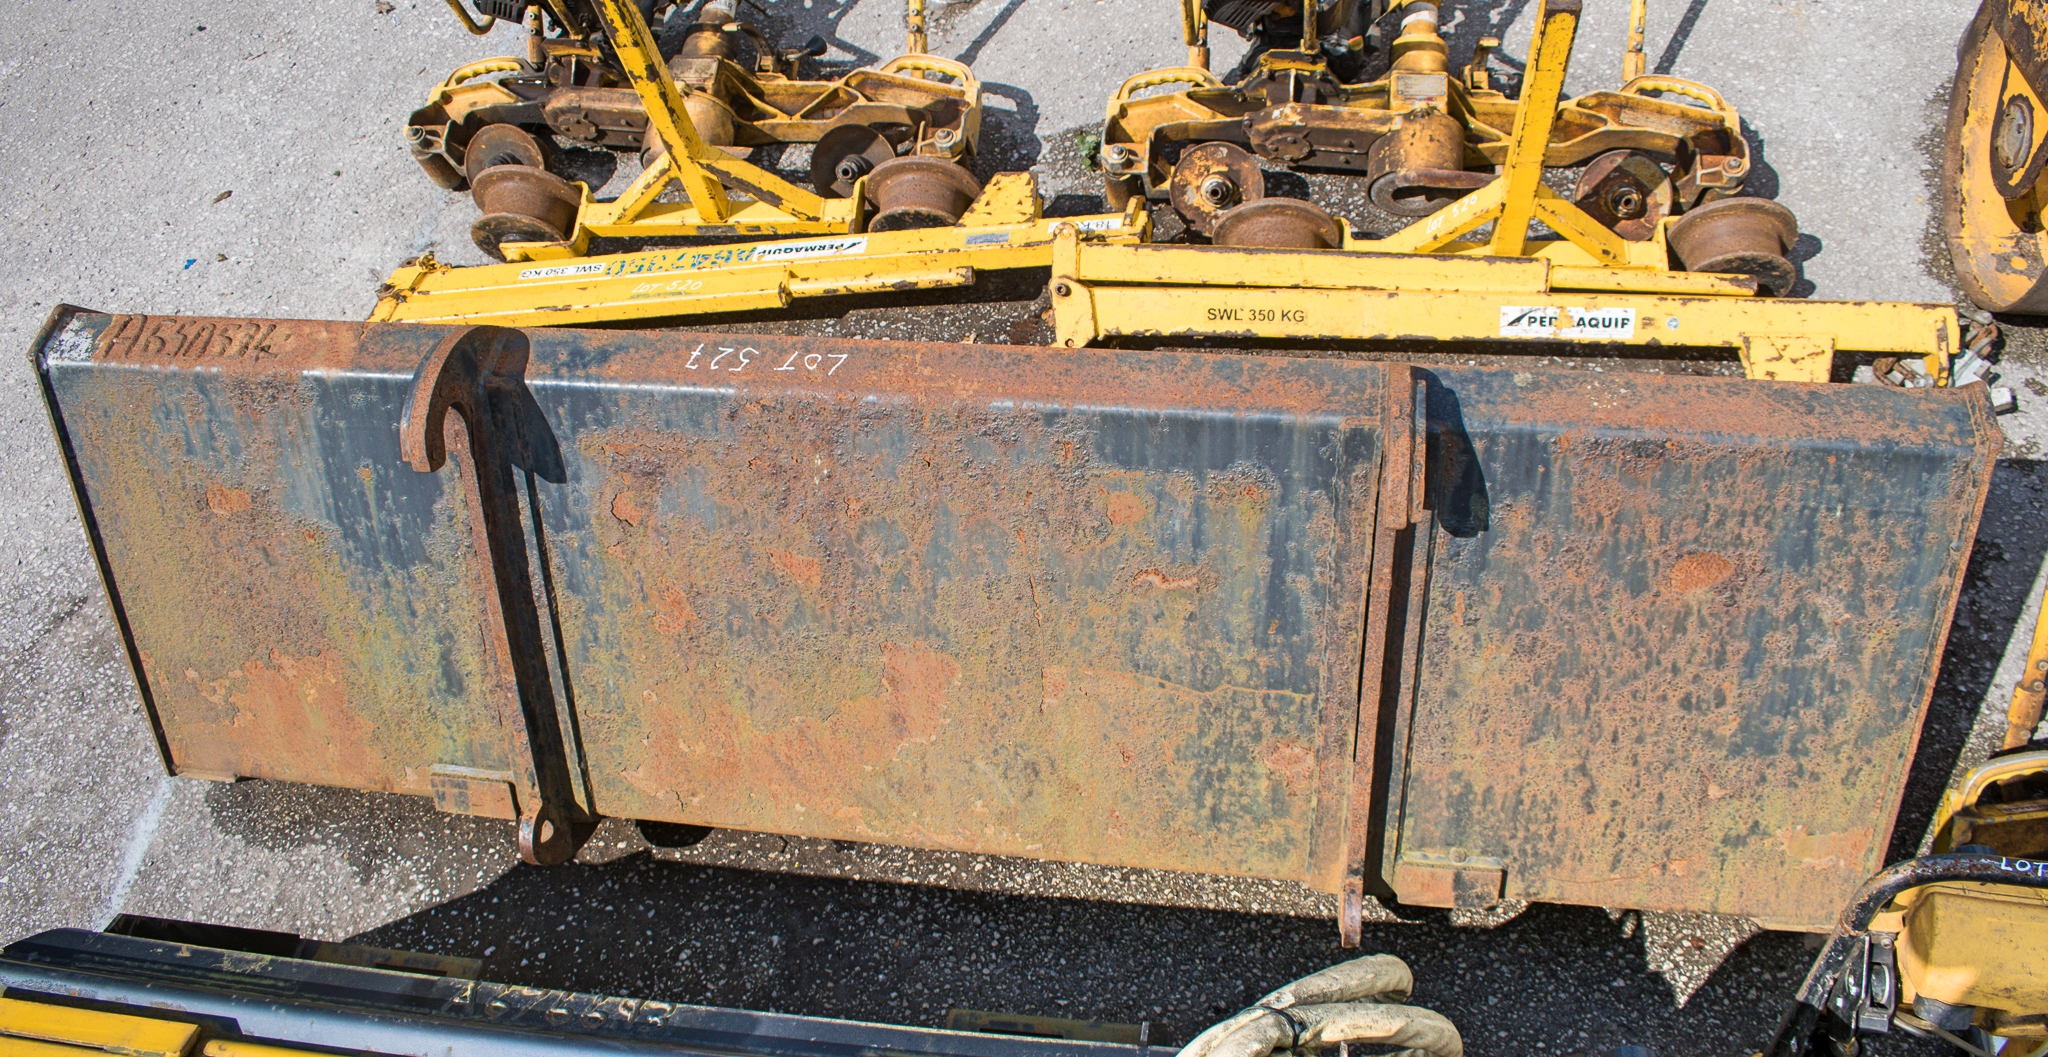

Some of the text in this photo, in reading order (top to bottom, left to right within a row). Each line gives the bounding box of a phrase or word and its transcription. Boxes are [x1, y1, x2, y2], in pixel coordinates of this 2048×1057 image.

[1426, 194, 1478, 234] LOT 520
[521, 264, 603, 279] SWL 350 KG
[631, 279, 703, 294] LOT 520
[1207, 308, 1305, 322] SWL 350 KG
[1528, 315, 1631, 329] PEAQUIP
[684, 343, 849, 376] LOT 527
[2000, 856, 2048, 877] LOT
